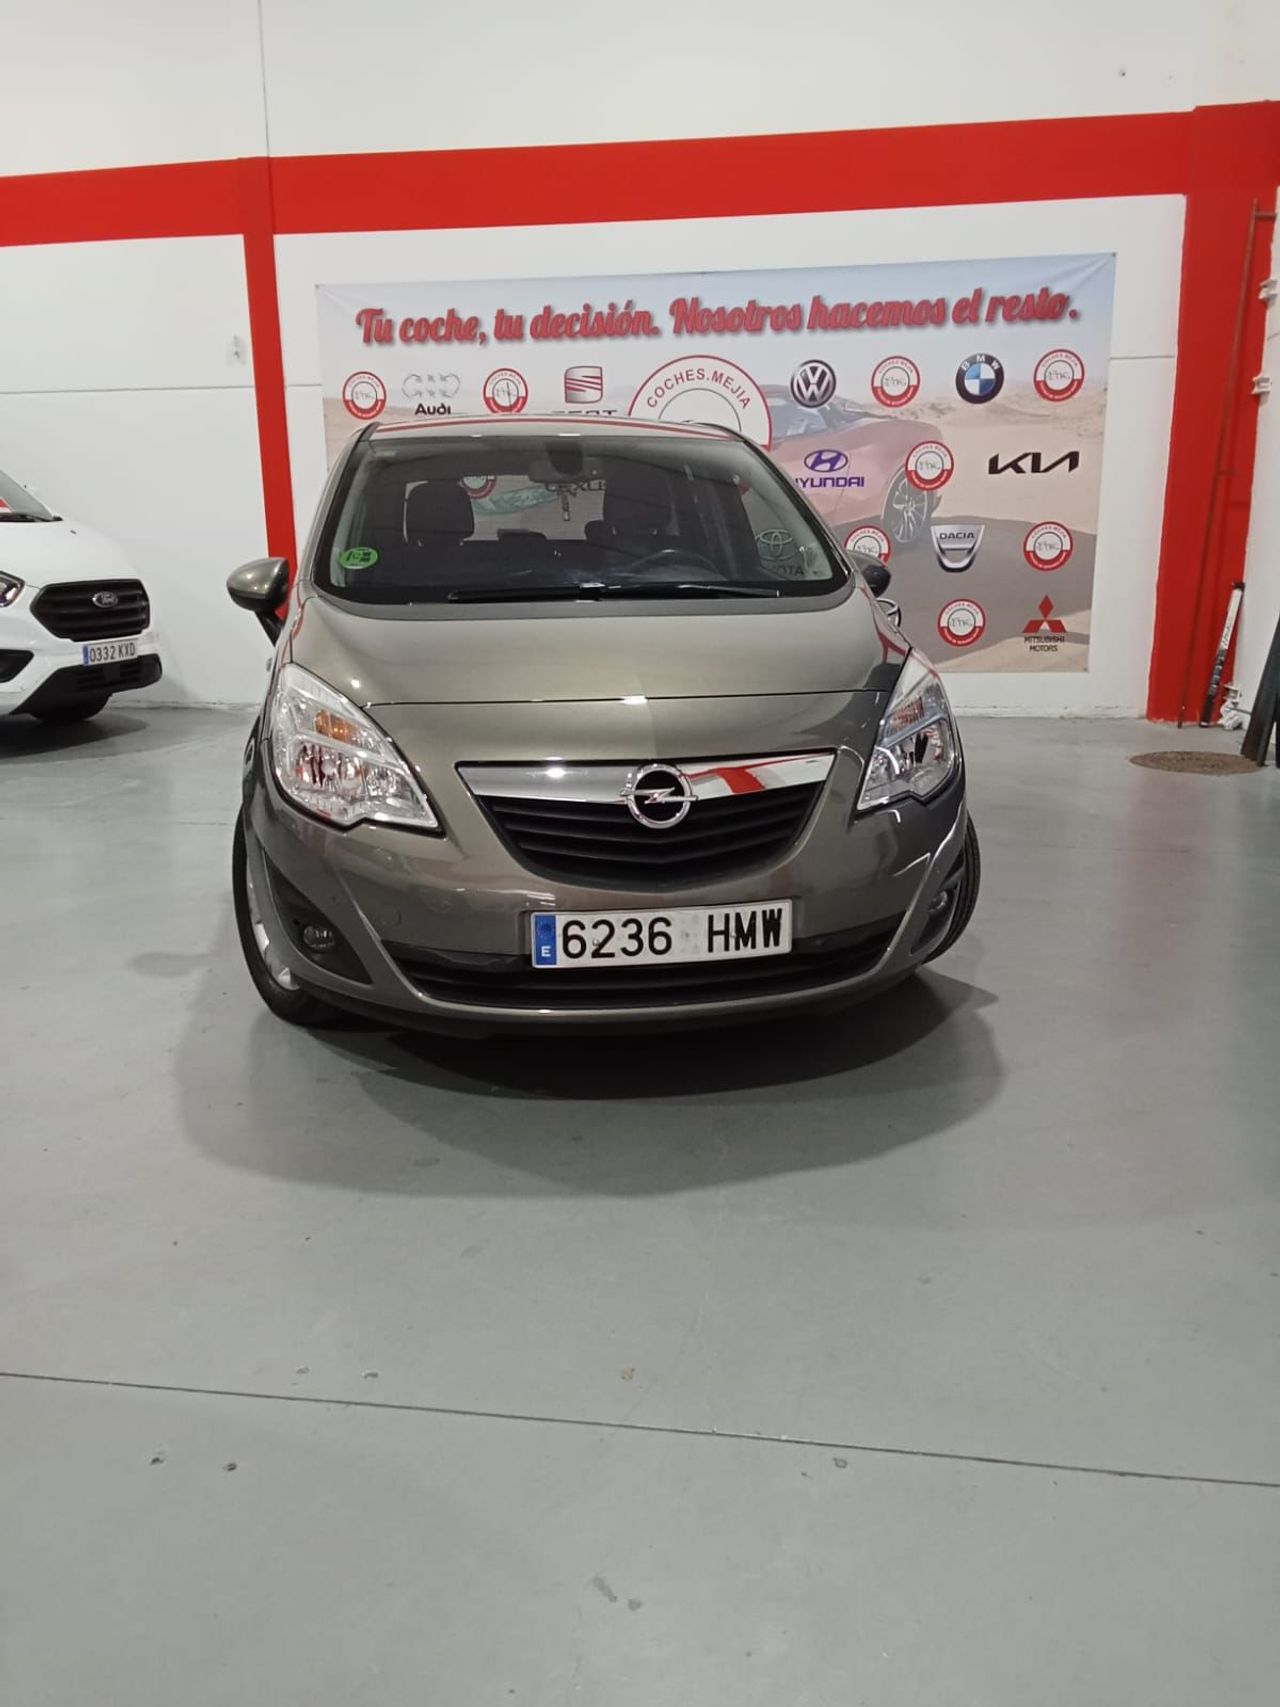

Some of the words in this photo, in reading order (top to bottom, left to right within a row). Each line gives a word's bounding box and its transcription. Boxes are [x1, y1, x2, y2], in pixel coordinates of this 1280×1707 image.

[356, 308, 393, 344] Tu
[399, 309, 486, 346] coche,
[494, 308, 524, 342] tu
[529, 300, 660, 340] decisión.
[669, 297, 801, 335] Nosotros
[807, 296, 946, 331] hacemos
[952, 288, 982, 324] el
[986, 287, 1078, 323] resto.
[414, 402, 452, 416] Audi
[795, 476, 865, 488] YUNDAI
[939, 532, 976, 540] DACIA
[89, 645, 115, 663] 0332
[562, 917, 673, 960] 6236
[707, 908, 783, 954] HMW
[541, 946, 551, 957] E
